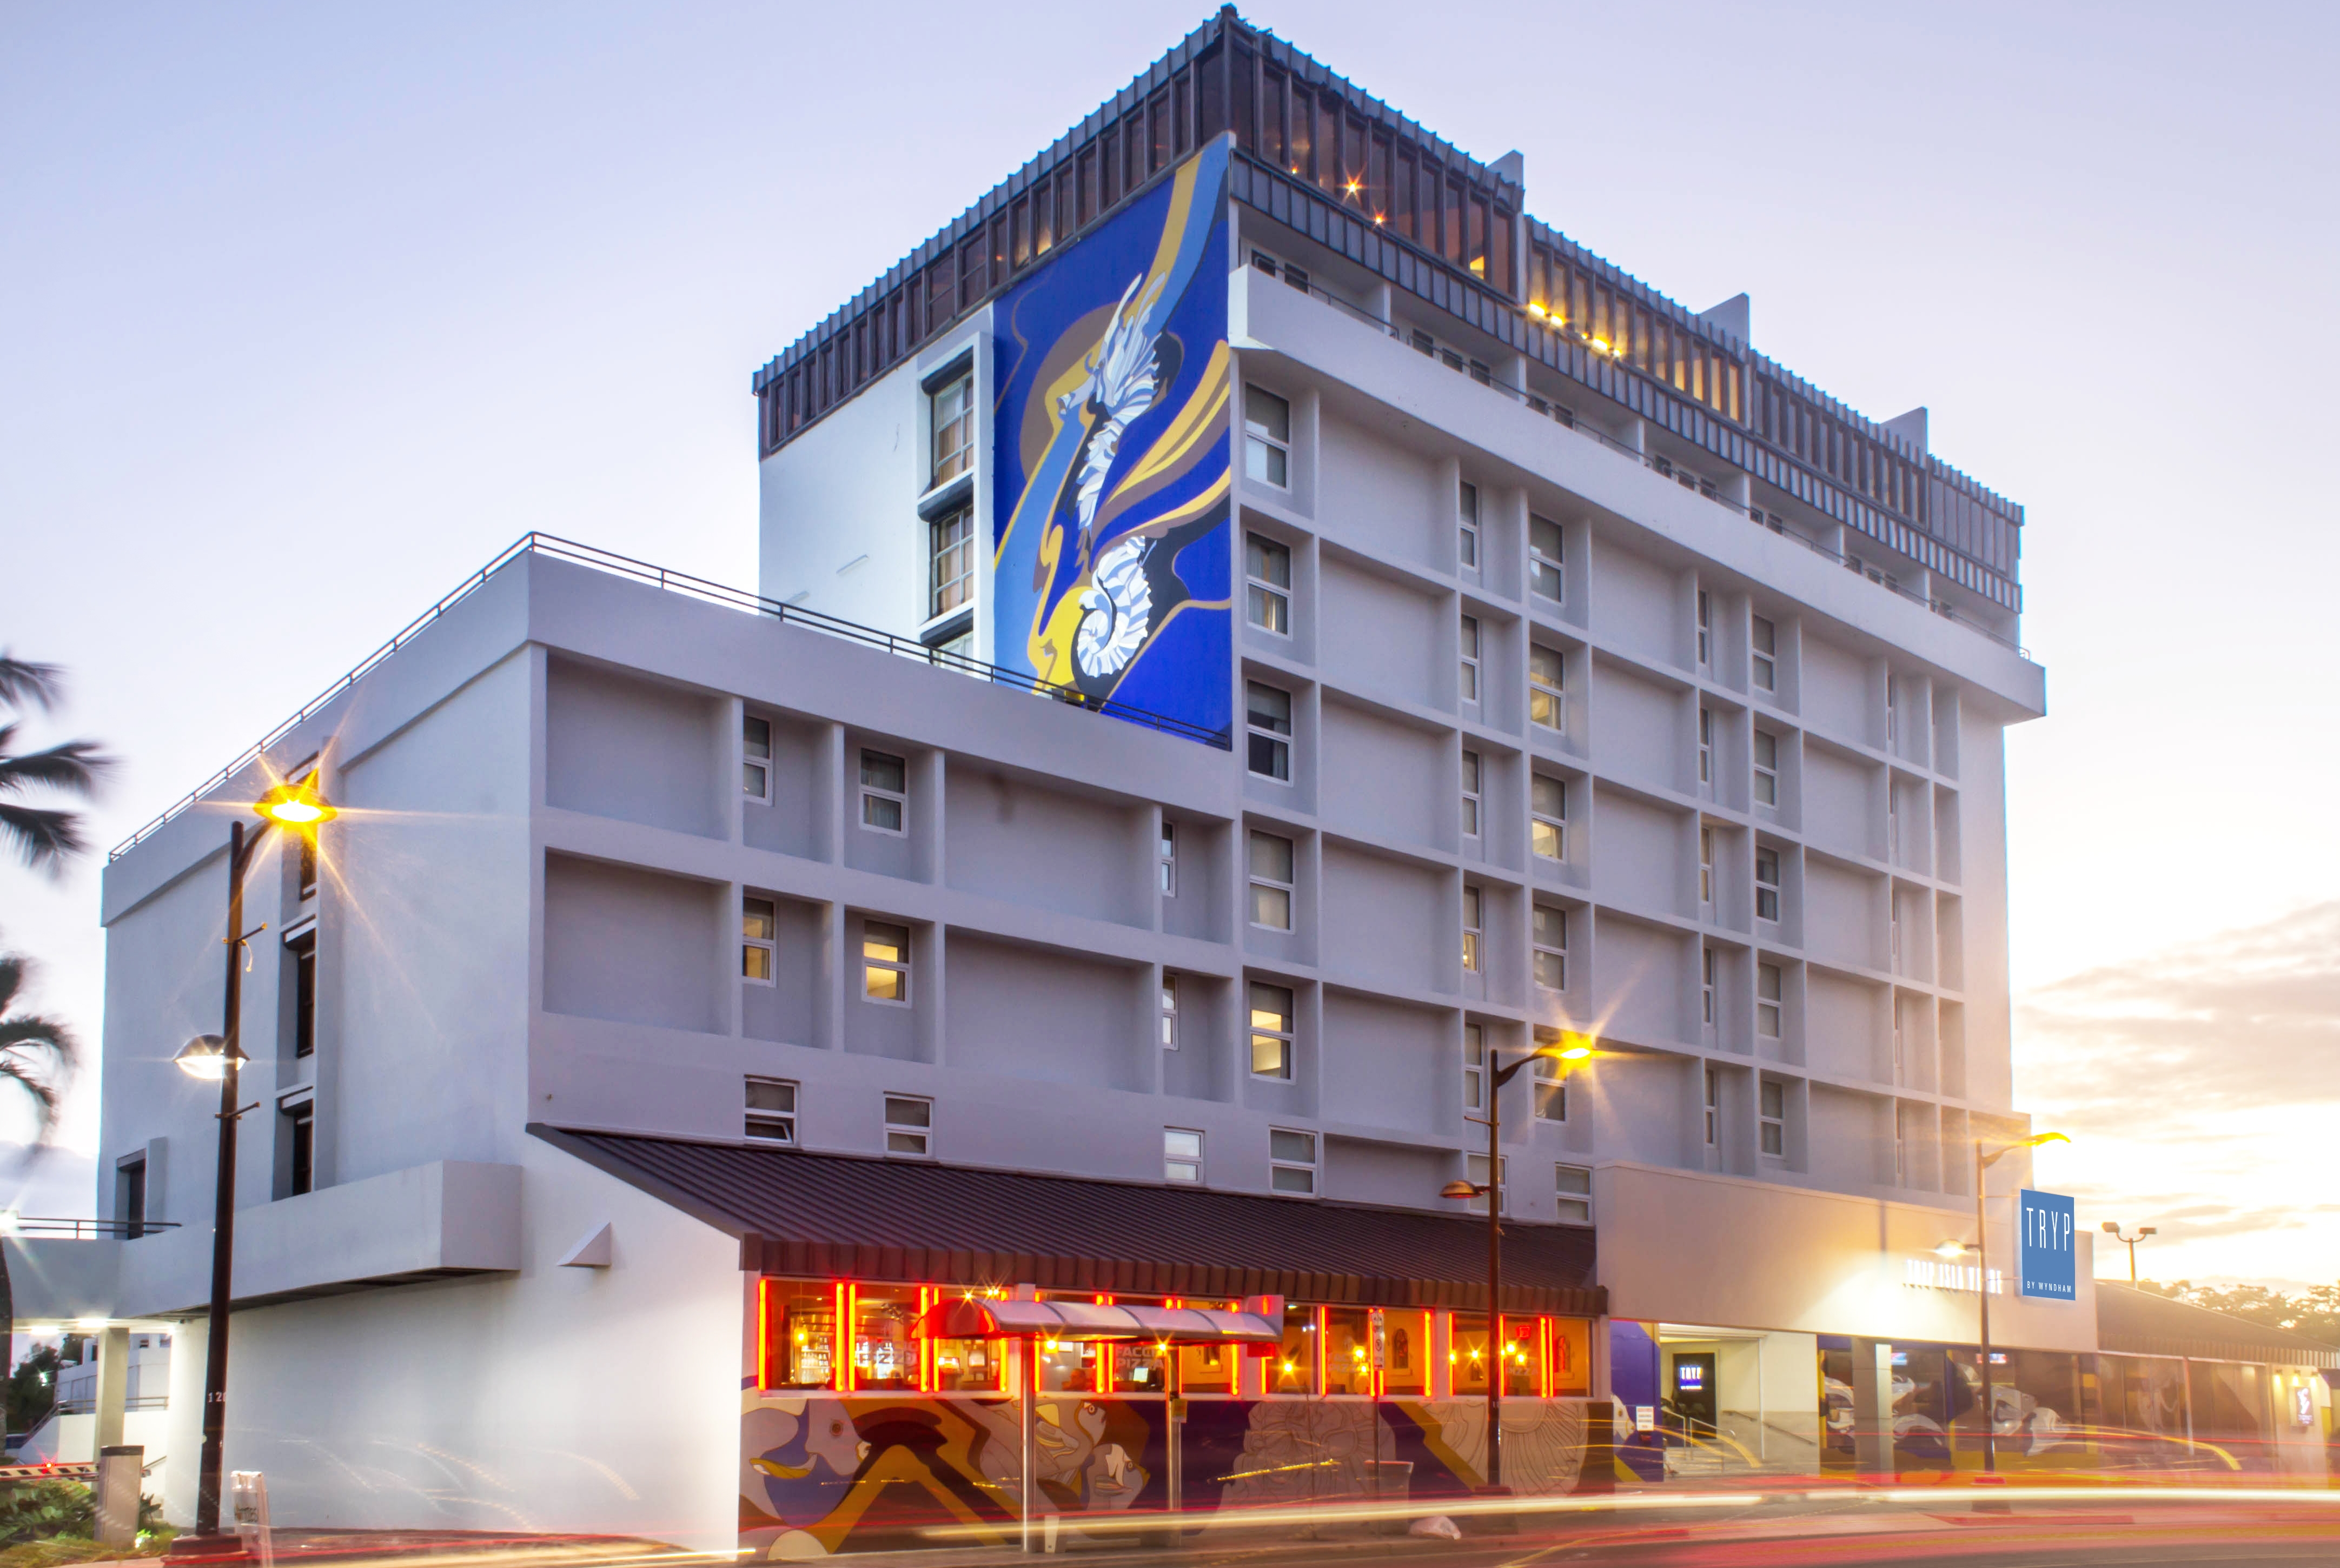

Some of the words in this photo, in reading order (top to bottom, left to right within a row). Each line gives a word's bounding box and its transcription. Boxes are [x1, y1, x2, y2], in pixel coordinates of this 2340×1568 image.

[2026, 1207, 2070, 1251] TRYP
[1939, 1264, 1964, 1290] ISLA
[2027, 1281, 2035, 1290] BY
[2039, 1282, 2071, 1293] WYNDHAM
[1116, 1358, 1164, 1368] PIZZA
